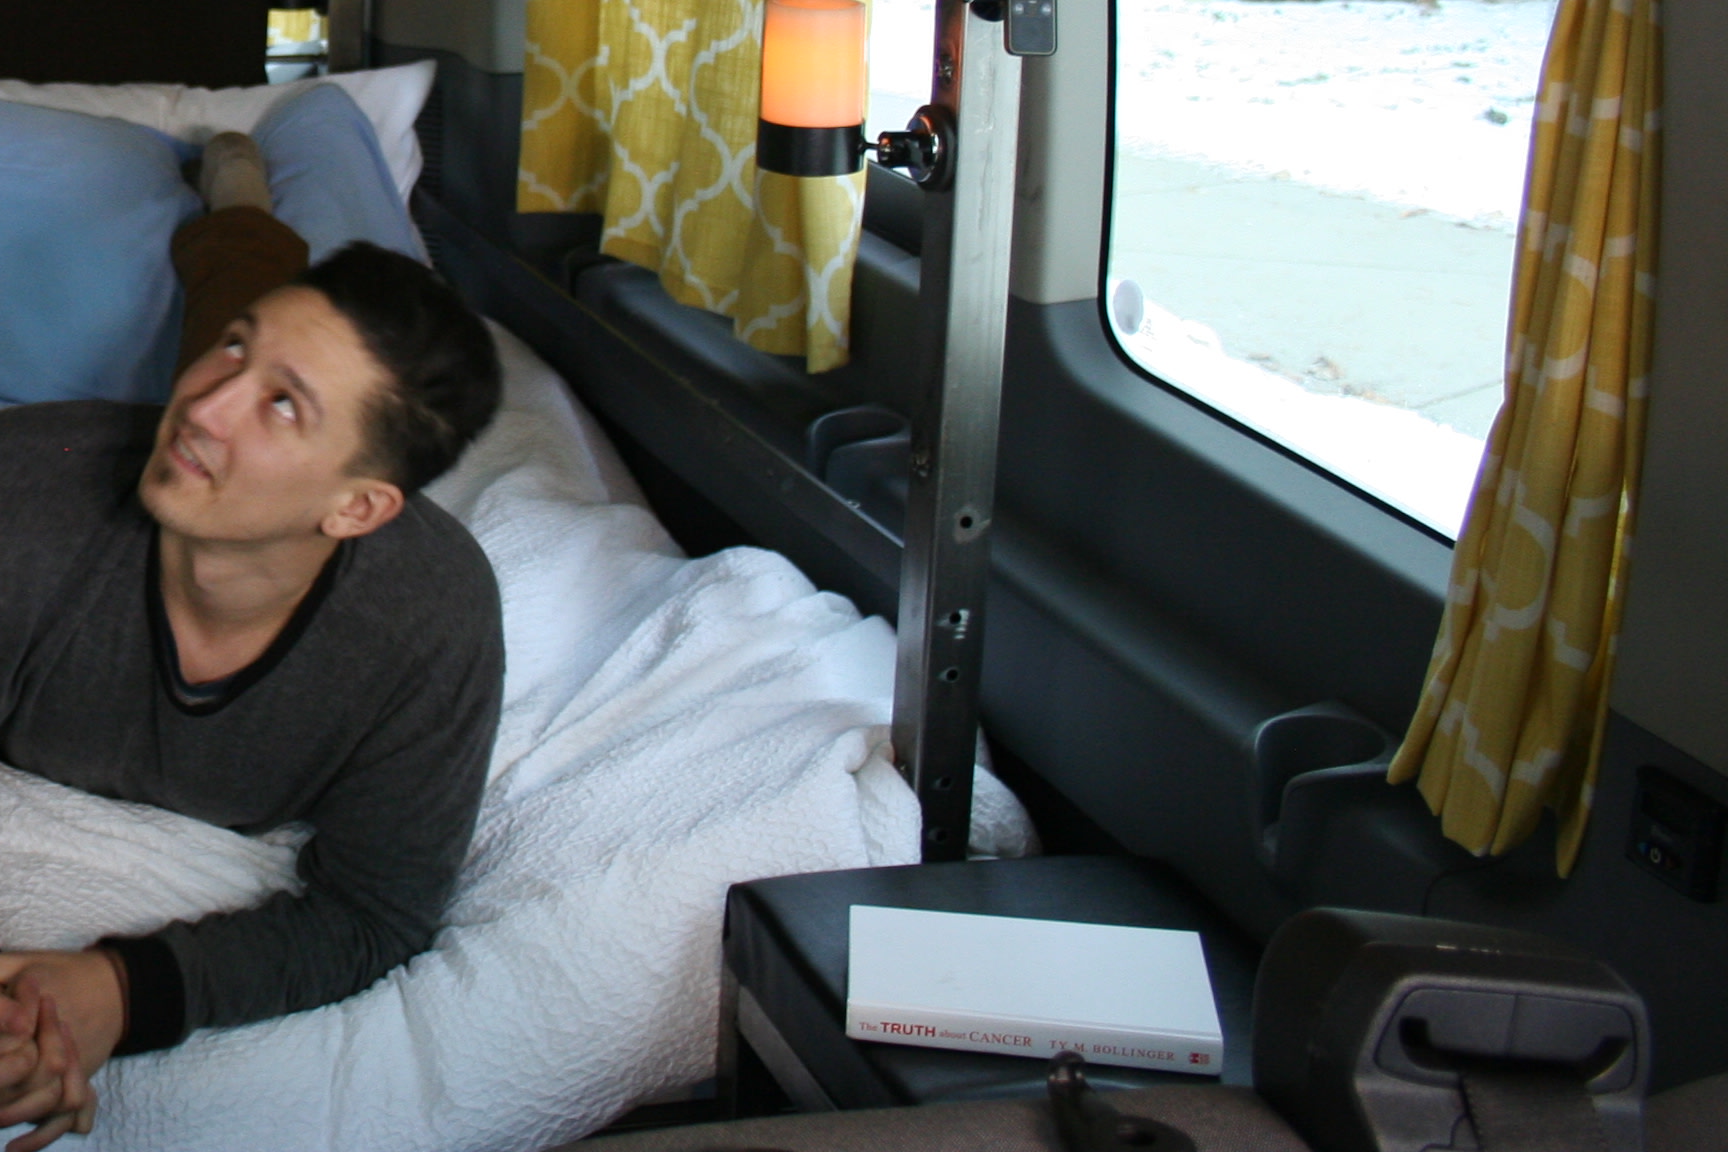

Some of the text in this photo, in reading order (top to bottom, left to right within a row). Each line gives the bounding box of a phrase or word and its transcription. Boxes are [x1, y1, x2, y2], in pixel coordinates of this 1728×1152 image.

[859, 1021, 1032, 1047] The TRUTH about CANCER
[1049, 1040, 1067, 1050] TY
[1093, 1044, 1175, 1061] BOLLINGER
